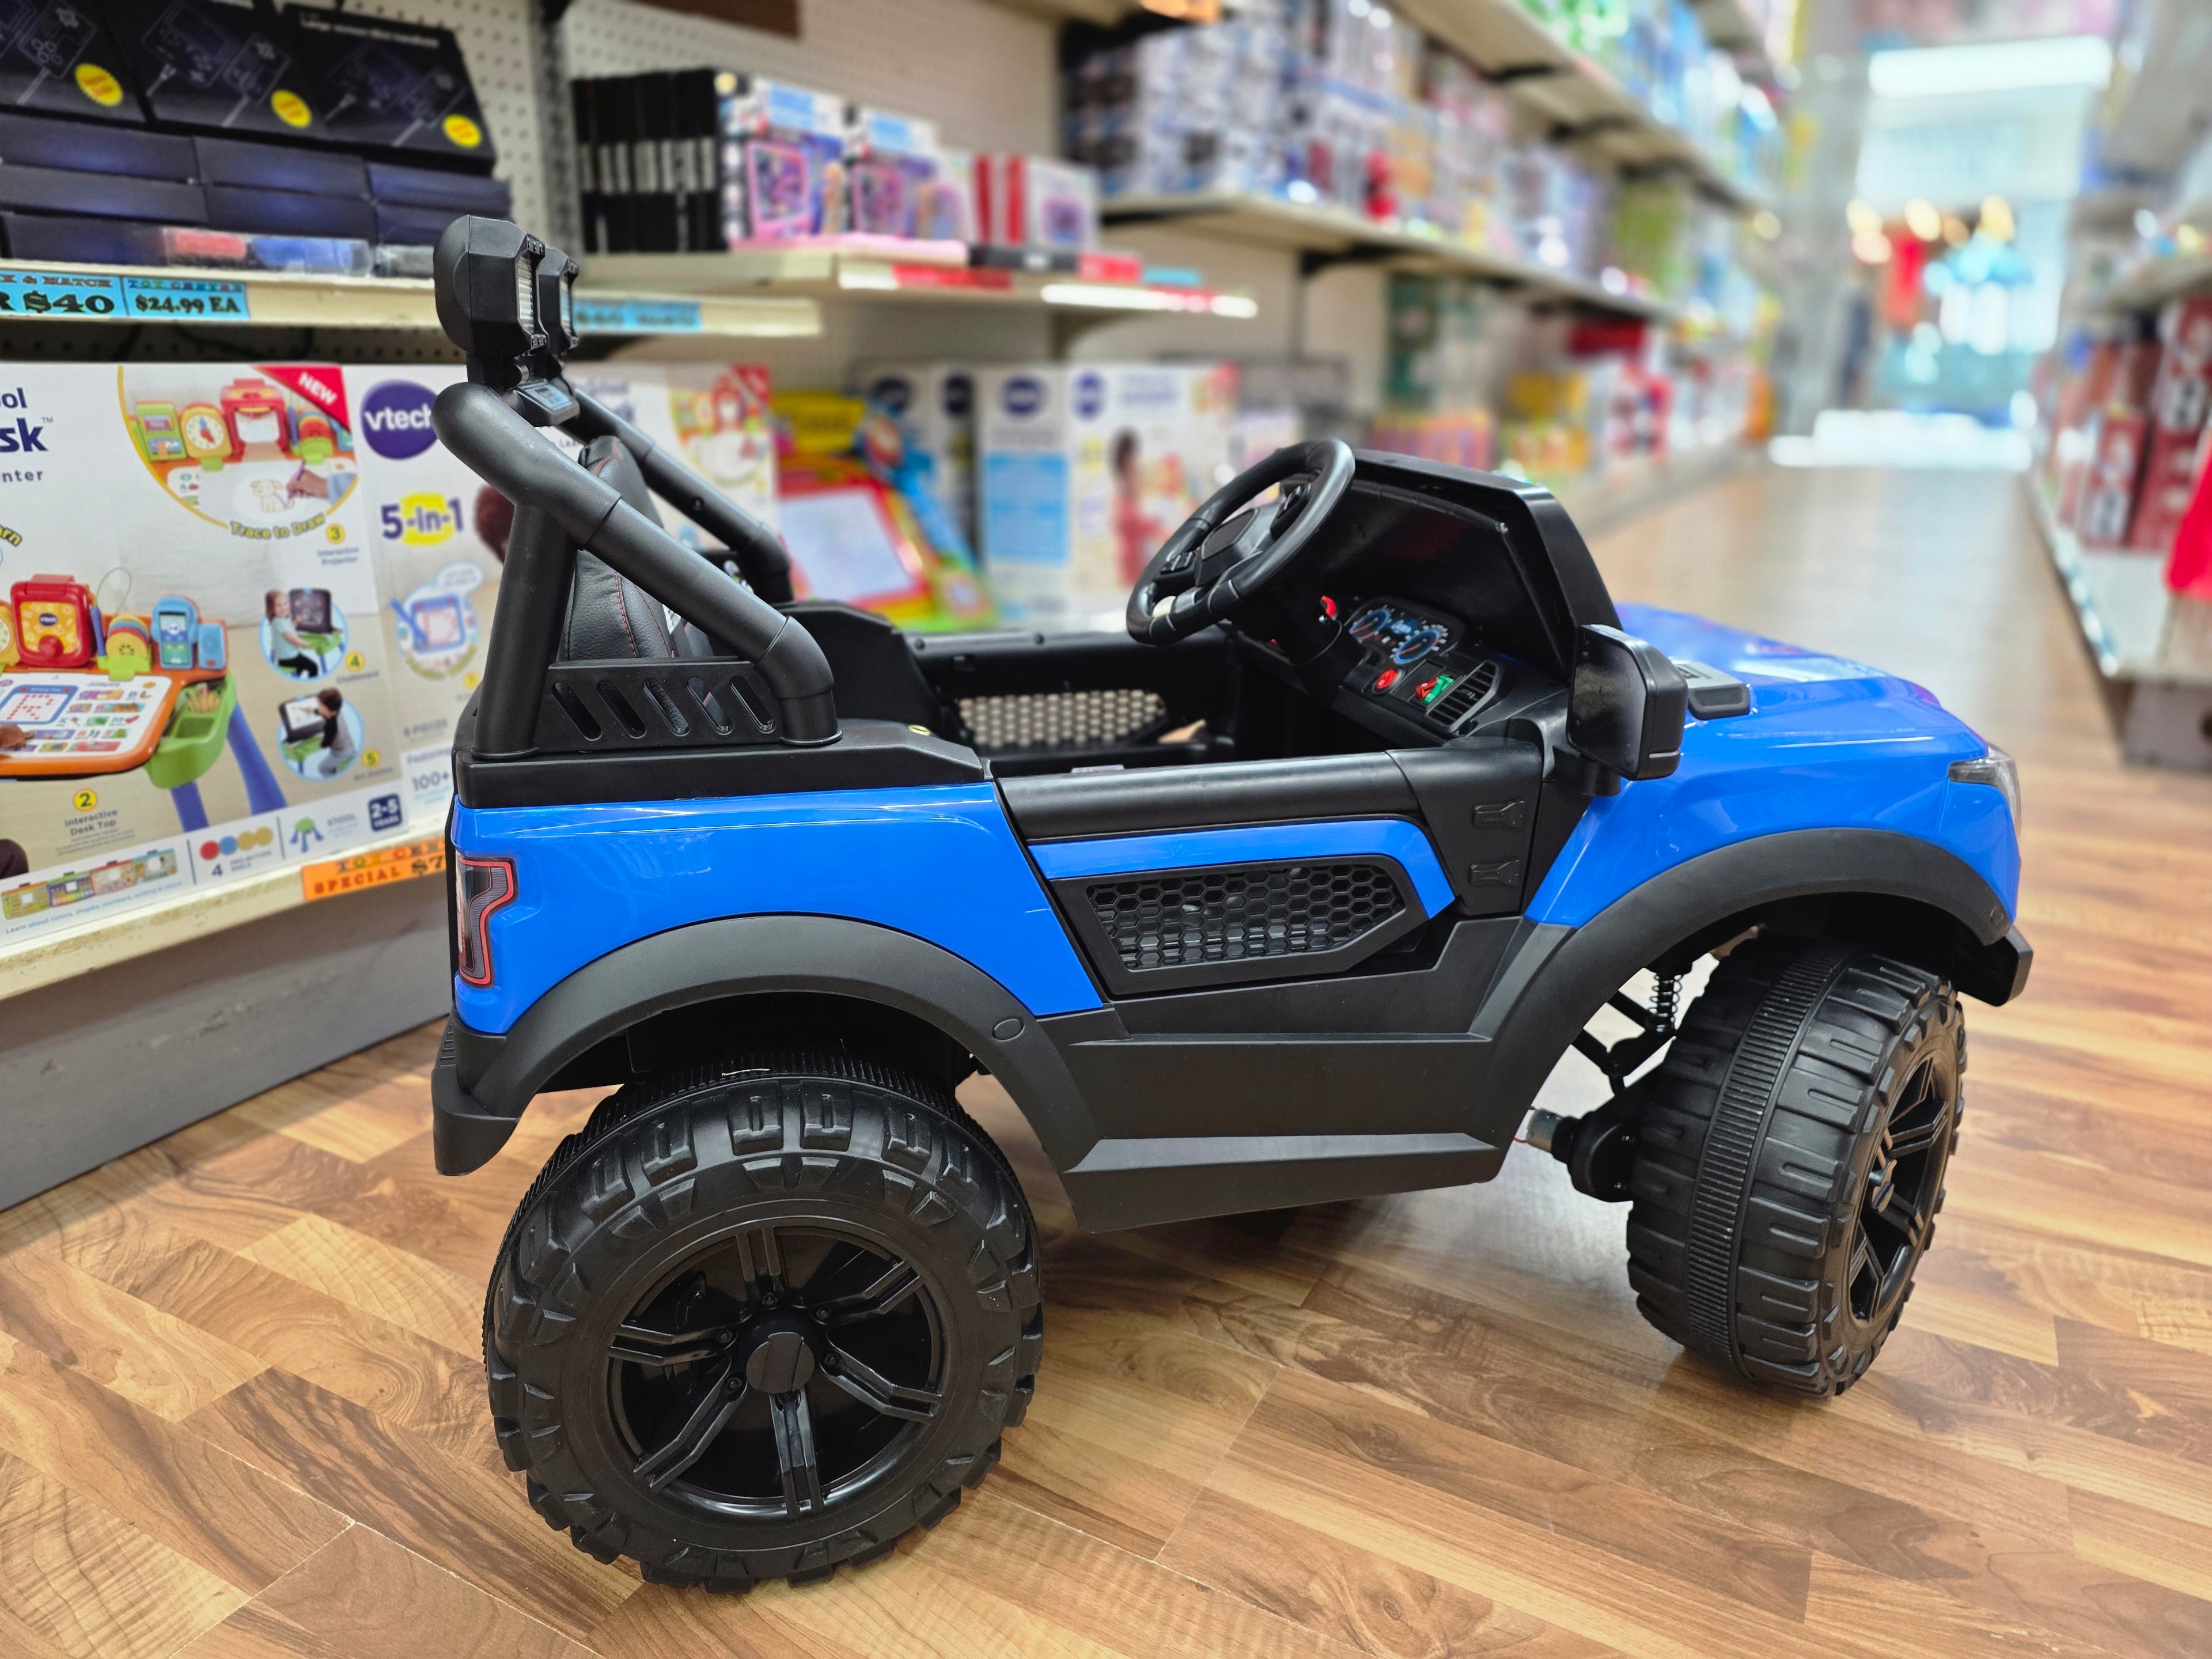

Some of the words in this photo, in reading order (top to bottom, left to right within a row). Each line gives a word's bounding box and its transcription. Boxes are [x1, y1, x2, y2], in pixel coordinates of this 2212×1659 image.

[42, 276, 112, 287] MATCH
[128, 280, 164, 289] TOY
[23, 289, 115, 314] $40
[135, 294, 204, 314] $24.99
[209, 296, 241, 313] EA
[298, 372, 338, 405] NEW
[230, 521, 271, 540] Trace
[273, 526, 290, 539] to
[291, 513, 325, 536] Draw
[381, 498, 464, 540] 5-in-1
[331, 527, 341, 540] 3
[350, 654, 361, 667] 4
[366, 752, 376, 766] 5
[412, 771, 449, 791] 100+
[79, 793, 93, 807] 2
[371, 798, 399, 819] 2-5
[65, 809, 118, 827] Interactive
[70, 824, 95, 836] Desk
[97, 819, 117, 830] Top
[211, 863, 224, 876] 4
[314, 866, 401, 894] SPECIAL
